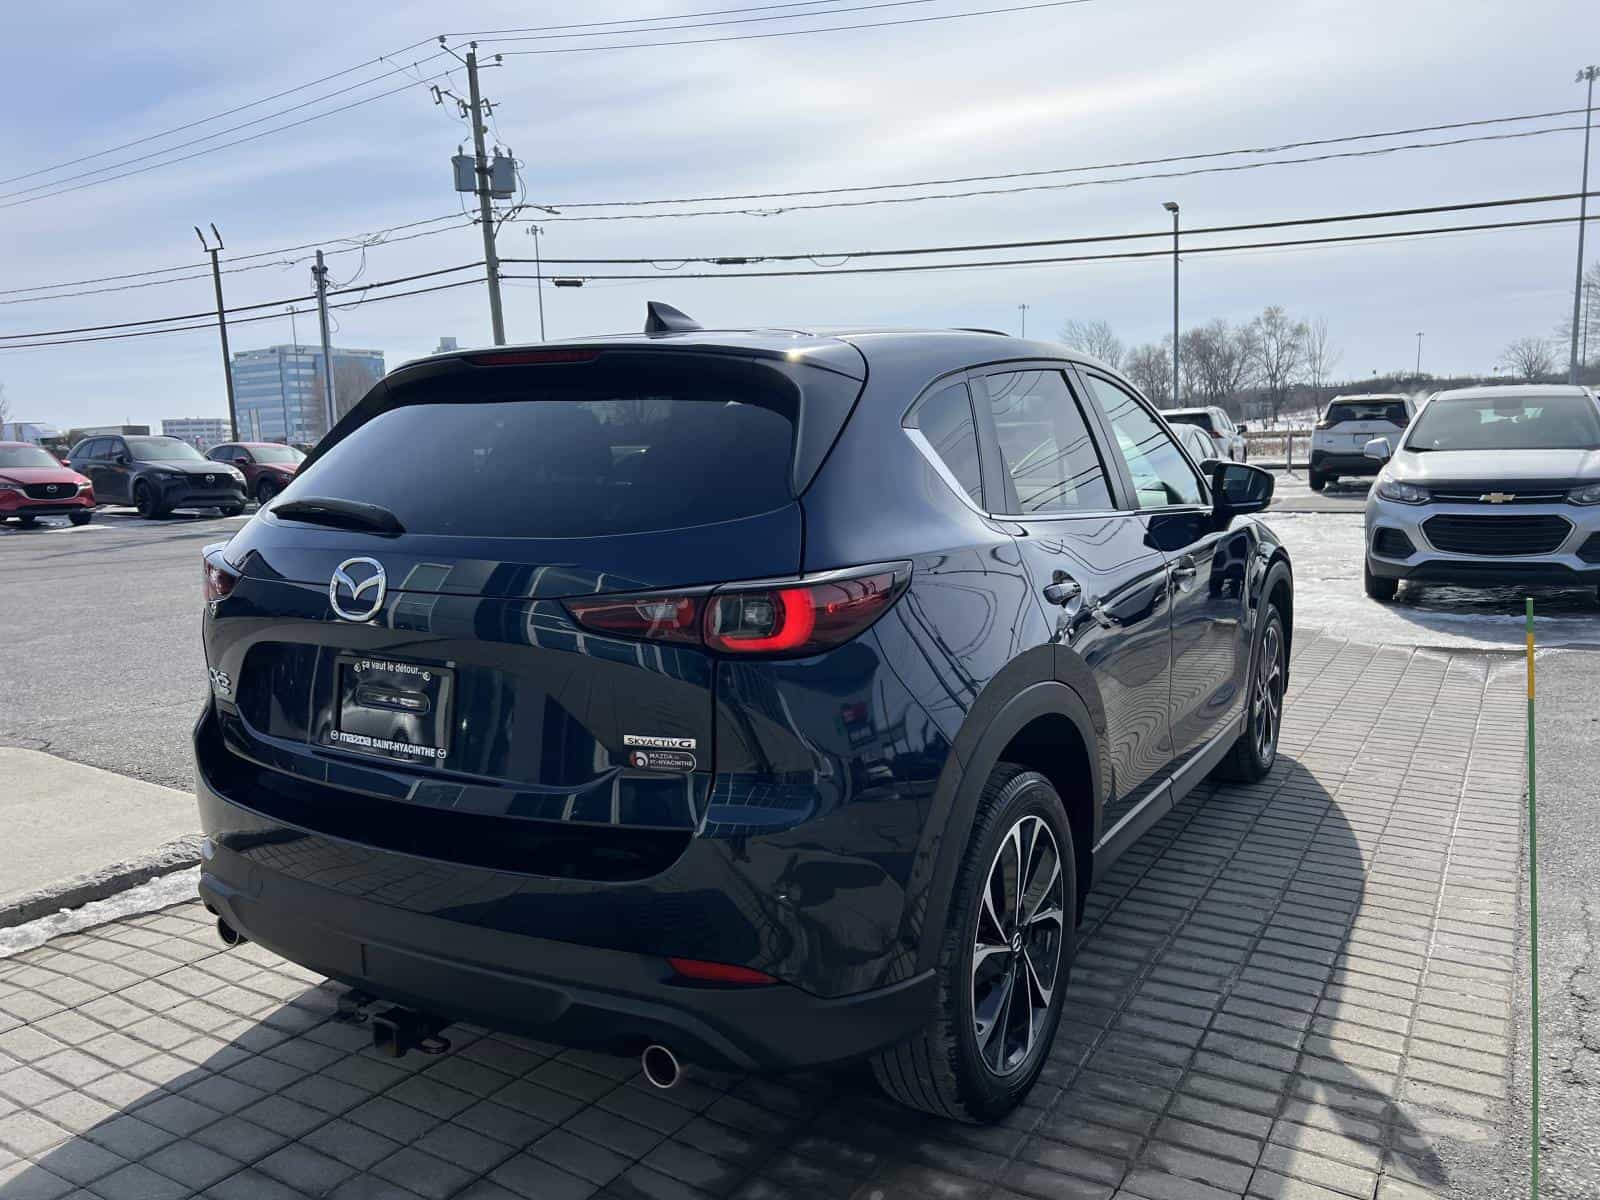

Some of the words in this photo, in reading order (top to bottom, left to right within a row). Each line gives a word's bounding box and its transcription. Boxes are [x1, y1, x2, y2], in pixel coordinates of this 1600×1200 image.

[371, 661, 386, 671] vaut
[387, 662, 394, 672] le
[373, 739, 435, 757] SAINT-HYACINTHE
